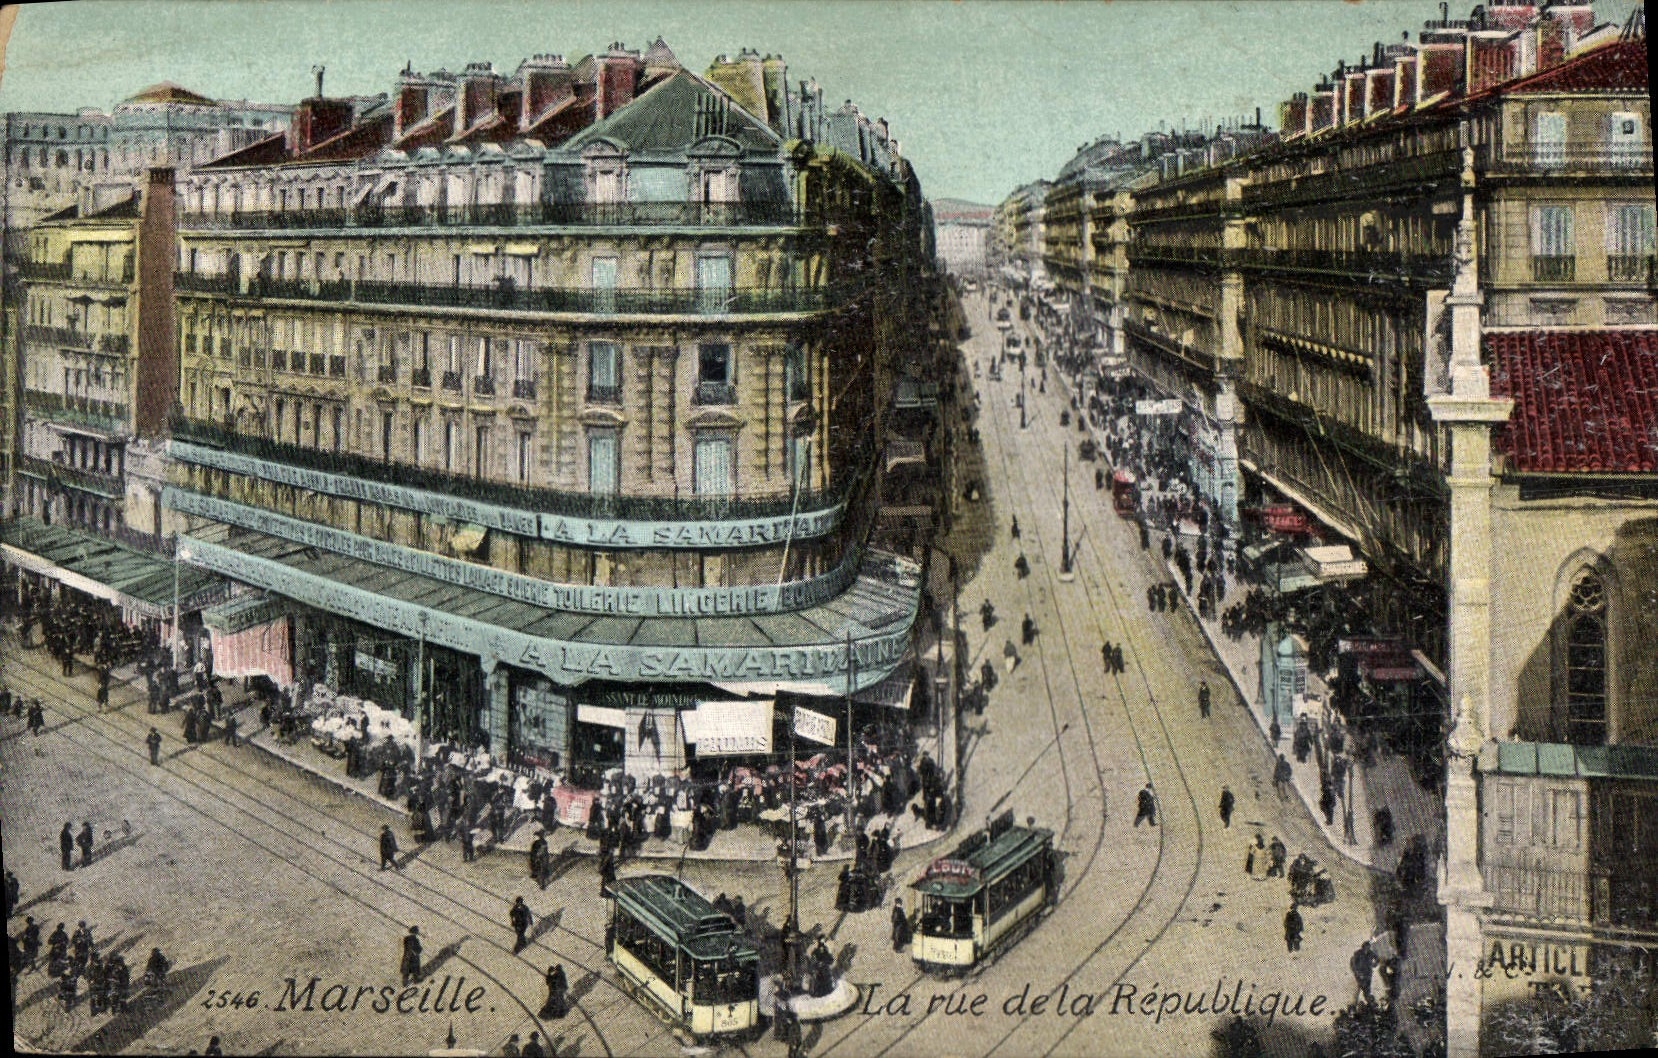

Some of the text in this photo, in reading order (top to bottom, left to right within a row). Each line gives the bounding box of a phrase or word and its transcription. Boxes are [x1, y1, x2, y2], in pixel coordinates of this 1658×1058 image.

[554, 519, 575, 541] A
[586, 521, 639, 545] LA
[553, 584, 640, 614] TOILERIE
[655, 588, 768, 614] LINGERIE
[520, 639, 546, 666] A
[561, 647, 620, 676] LA
